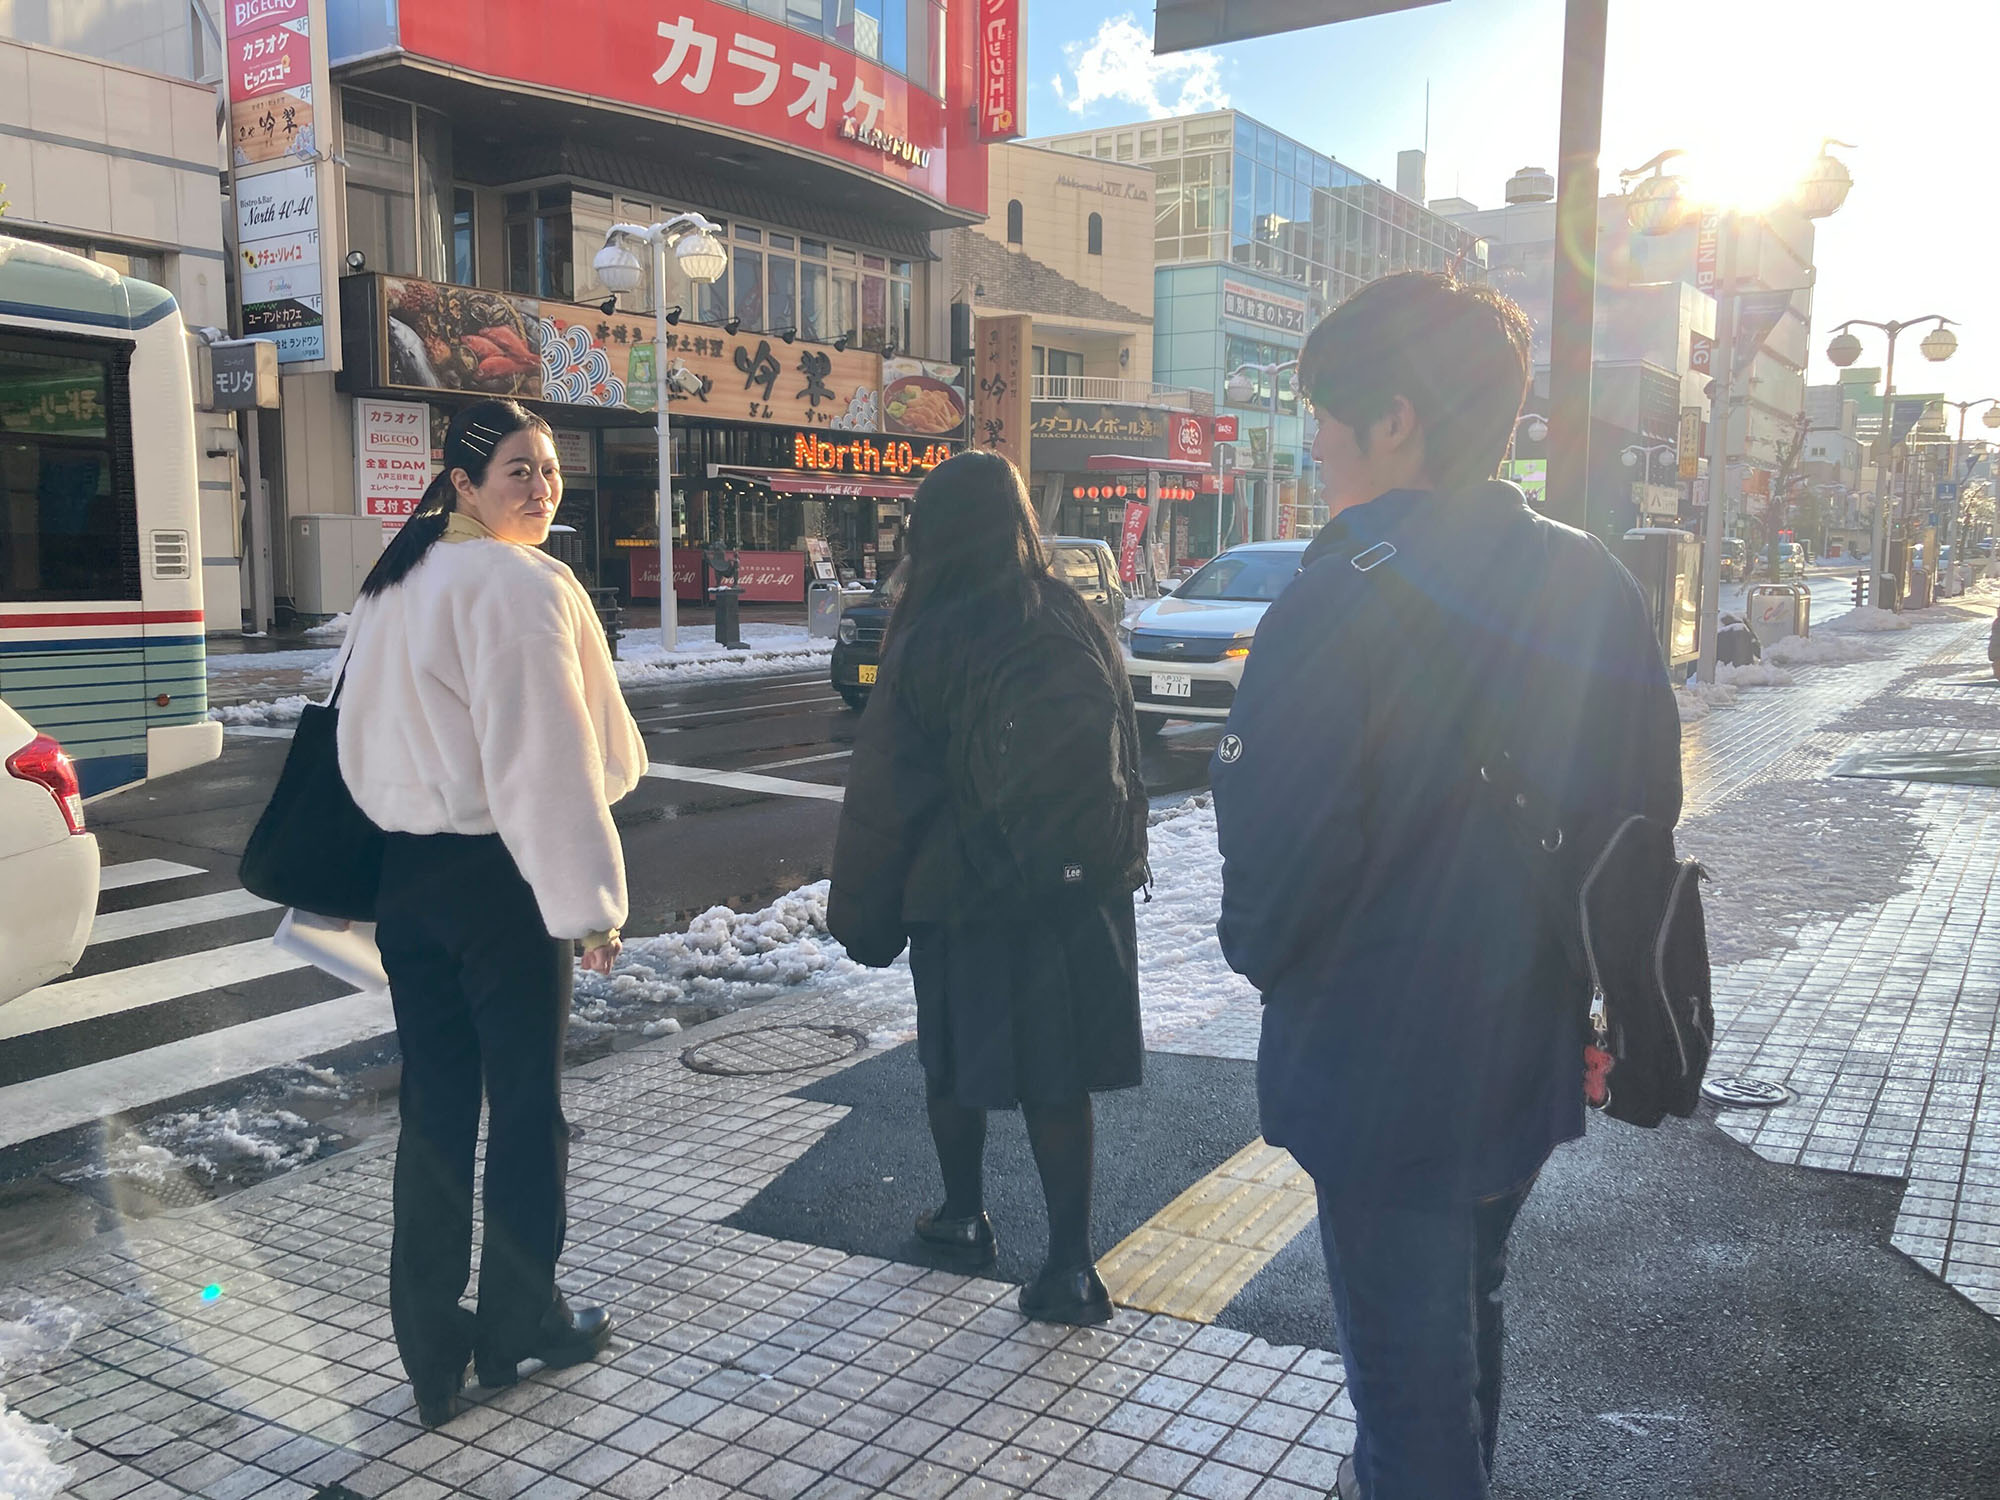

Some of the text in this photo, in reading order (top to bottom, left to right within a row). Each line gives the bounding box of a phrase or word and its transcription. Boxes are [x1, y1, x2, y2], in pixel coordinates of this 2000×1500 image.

[235, 0, 259, 26] BIG
[296, 19, 309, 32] 3F
[243, 32, 290, 61] カラオケ
[244, 63, 291, 90] ビッグエコー
[652, 15, 886, 131] カラオケ
[987, 18, 1006, 133] ビッグエコー
[299, 86, 312, 99] 2F
[304, 166, 315, 178] 1F
[244, 195, 314, 227] North 40-40
[307, 232, 319, 244] 1F
[311, 296, 322, 309] 1F
[262, 309, 282, 324] アンド
[283, 308, 302, 321] カフェ
[1226, 293, 1303, 330] 個別教室のトライ
[289, 336, 319, 350] ランドワン
[215, 370, 254, 393] モリタ
[370, 410, 419, 425] カラオケ
[370, 432, 390, 444] BIG
[391, 435, 420, 447] ECHO
[794, 431, 881, 473] North
[366, 458, 426, 471] 全室 DAM
[370, 484, 406, 492] エレベーター
[374, 499, 399, 514] 受付
[755, 573, 795, 585] 40-40
[1066, 869, 1081, 878] Lee
